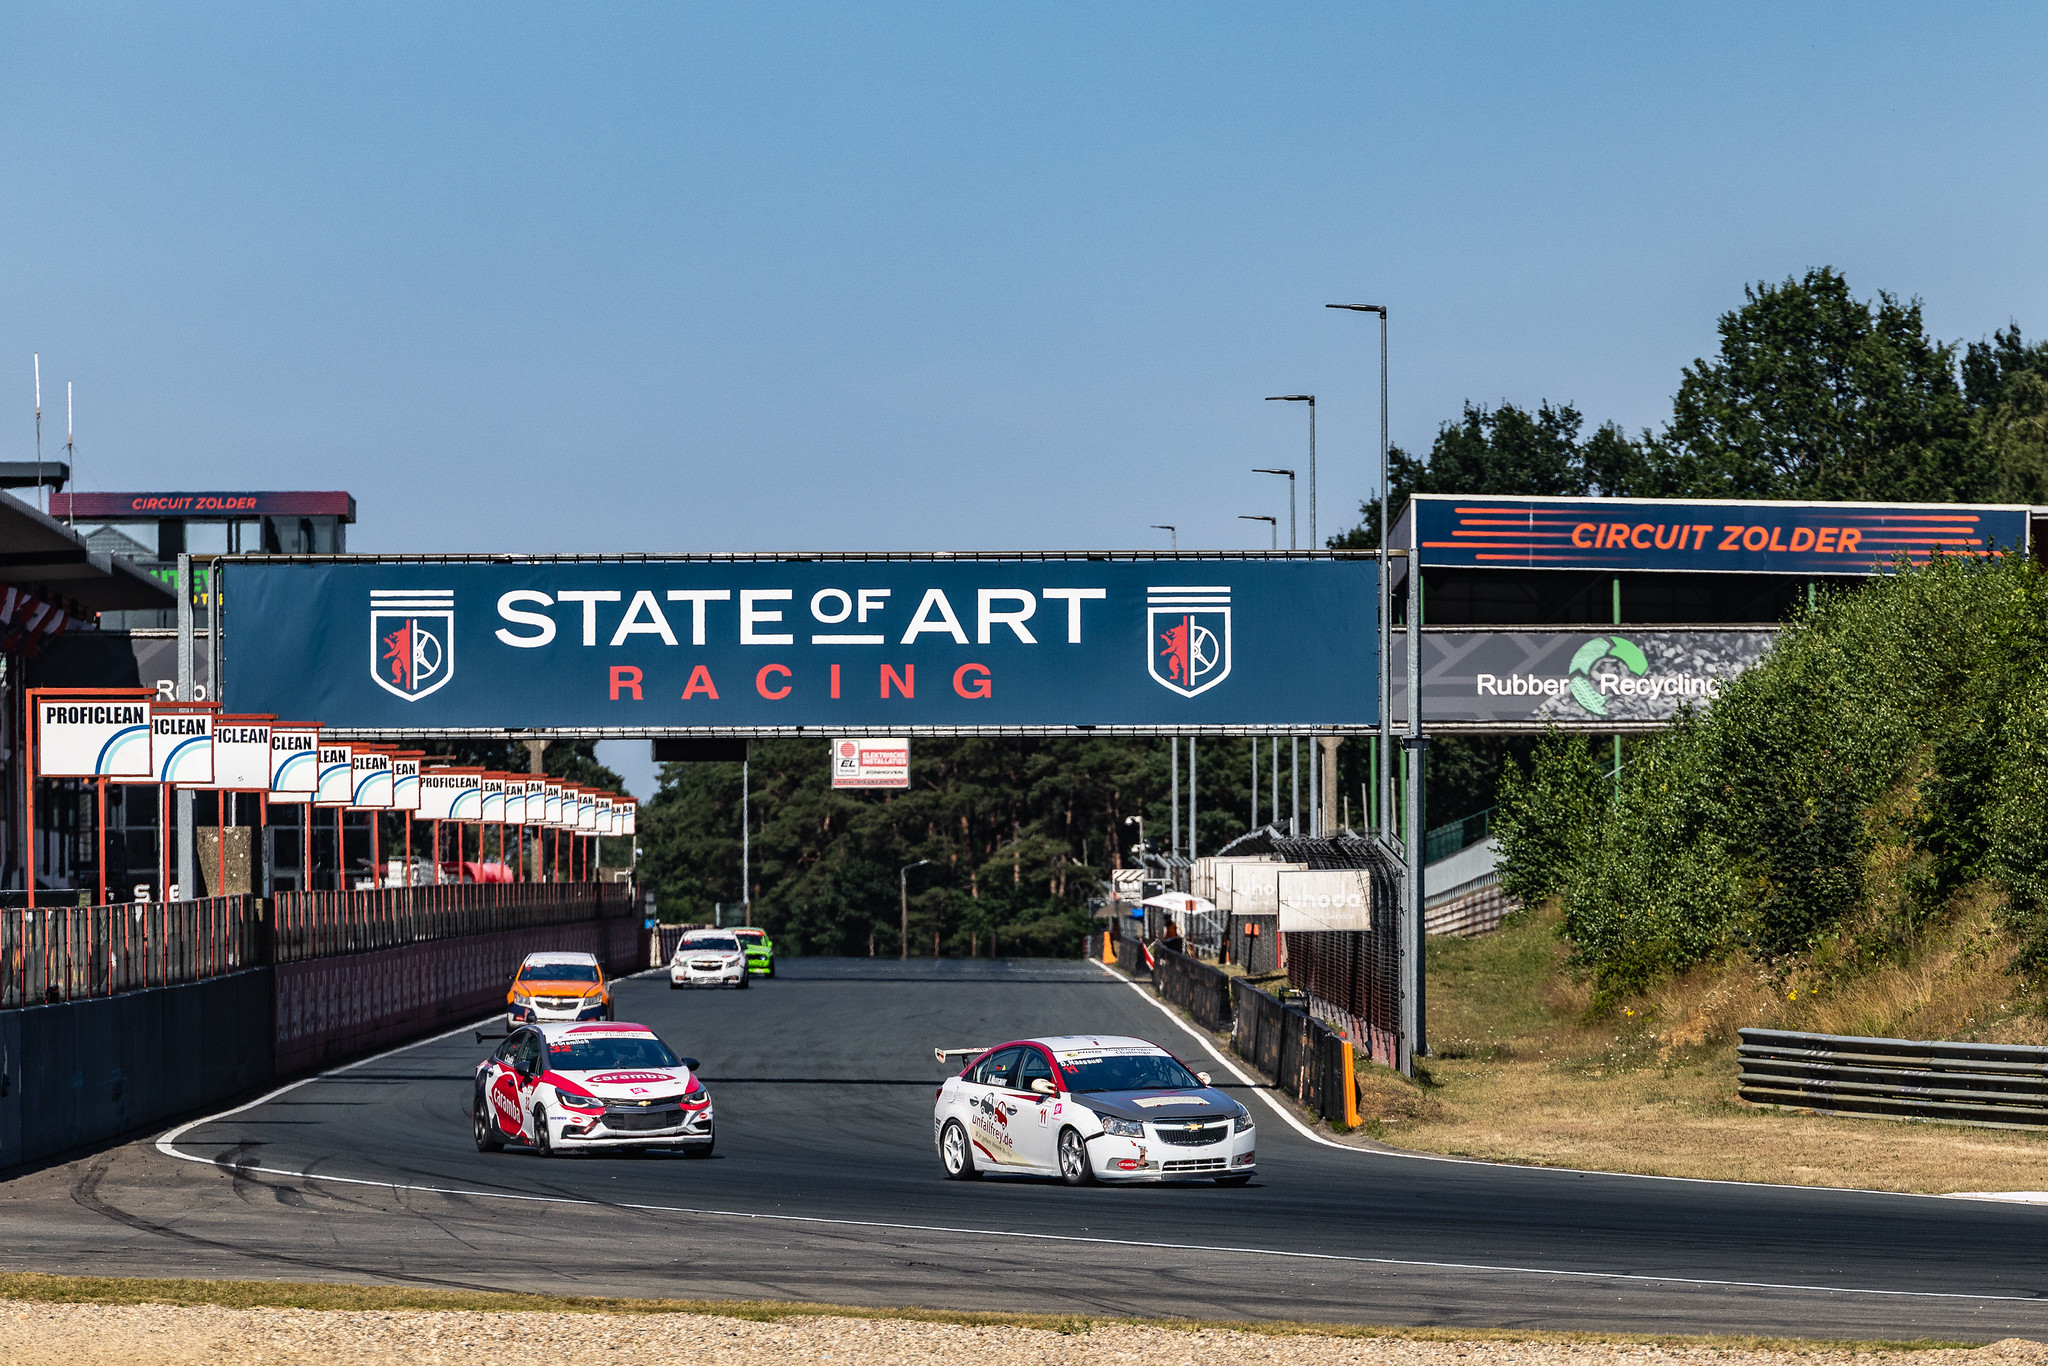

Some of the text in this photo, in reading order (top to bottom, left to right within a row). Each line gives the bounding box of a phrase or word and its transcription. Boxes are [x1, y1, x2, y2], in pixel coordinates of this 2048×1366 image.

[131, 497, 257, 511] CIRCUIT ZOLDER
[1571, 522, 1862, 554] CIRCUIT ZOLDER
[495, 587, 1107, 648] STATE OF ART
[609, 662, 993, 702] RACING
[1477, 673, 1721, 700] Rubber Recycling
[46, 706, 144, 724] PROFICLEAN
[152, 718, 206, 735] ICLEAN
[394, 763, 416, 775] EAN
[840, 759, 856, 768] EL
[420, 777, 479, 788] PROFICLEAN
[1287, 881, 1361, 908] uhoda
[1326, 911, 1355, 920] Service
[549, 1045, 573, 1053] 32
[592, 1071, 669, 1083] caramba
[494, 1087, 521, 1124] caramba
[1040, 1108, 1048, 1124] 11
[971, 1114, 1013, 1149] unfallfrey.de
